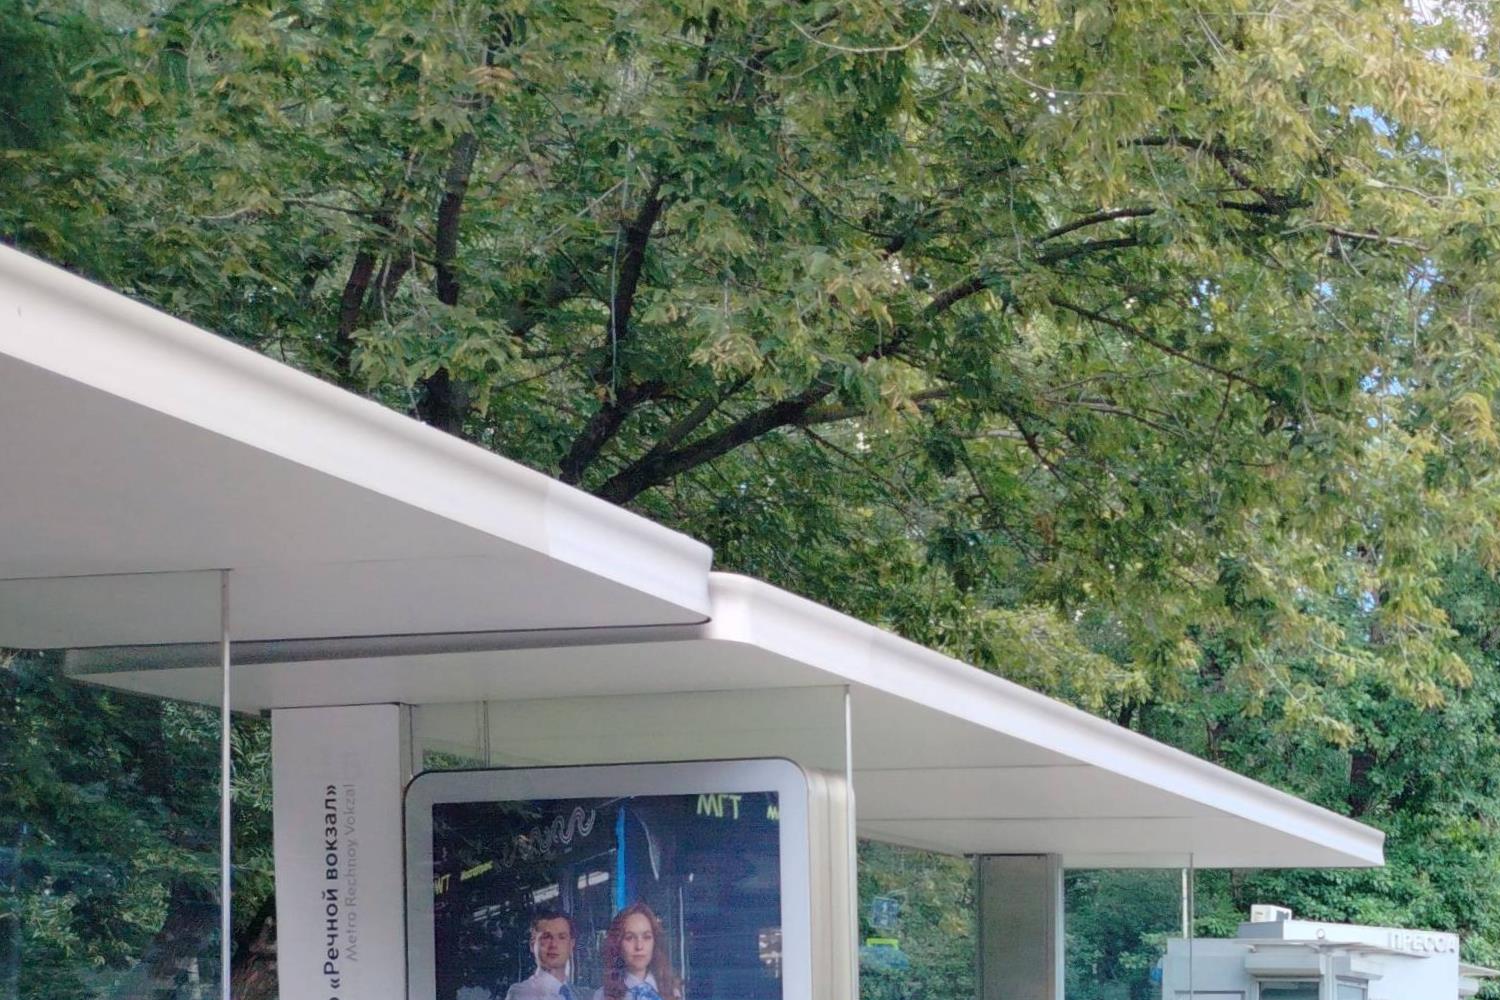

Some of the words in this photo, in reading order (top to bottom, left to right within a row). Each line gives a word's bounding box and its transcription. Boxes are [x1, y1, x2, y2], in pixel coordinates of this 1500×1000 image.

[325, 785, 339, 880] вокзал»
[343, 784, 356, 836] Vokzal
[344, 840, 358, 907] Rechnoy
[322, 889, 340, 989] «Речной
[345, 912, 358, 961] Metro
